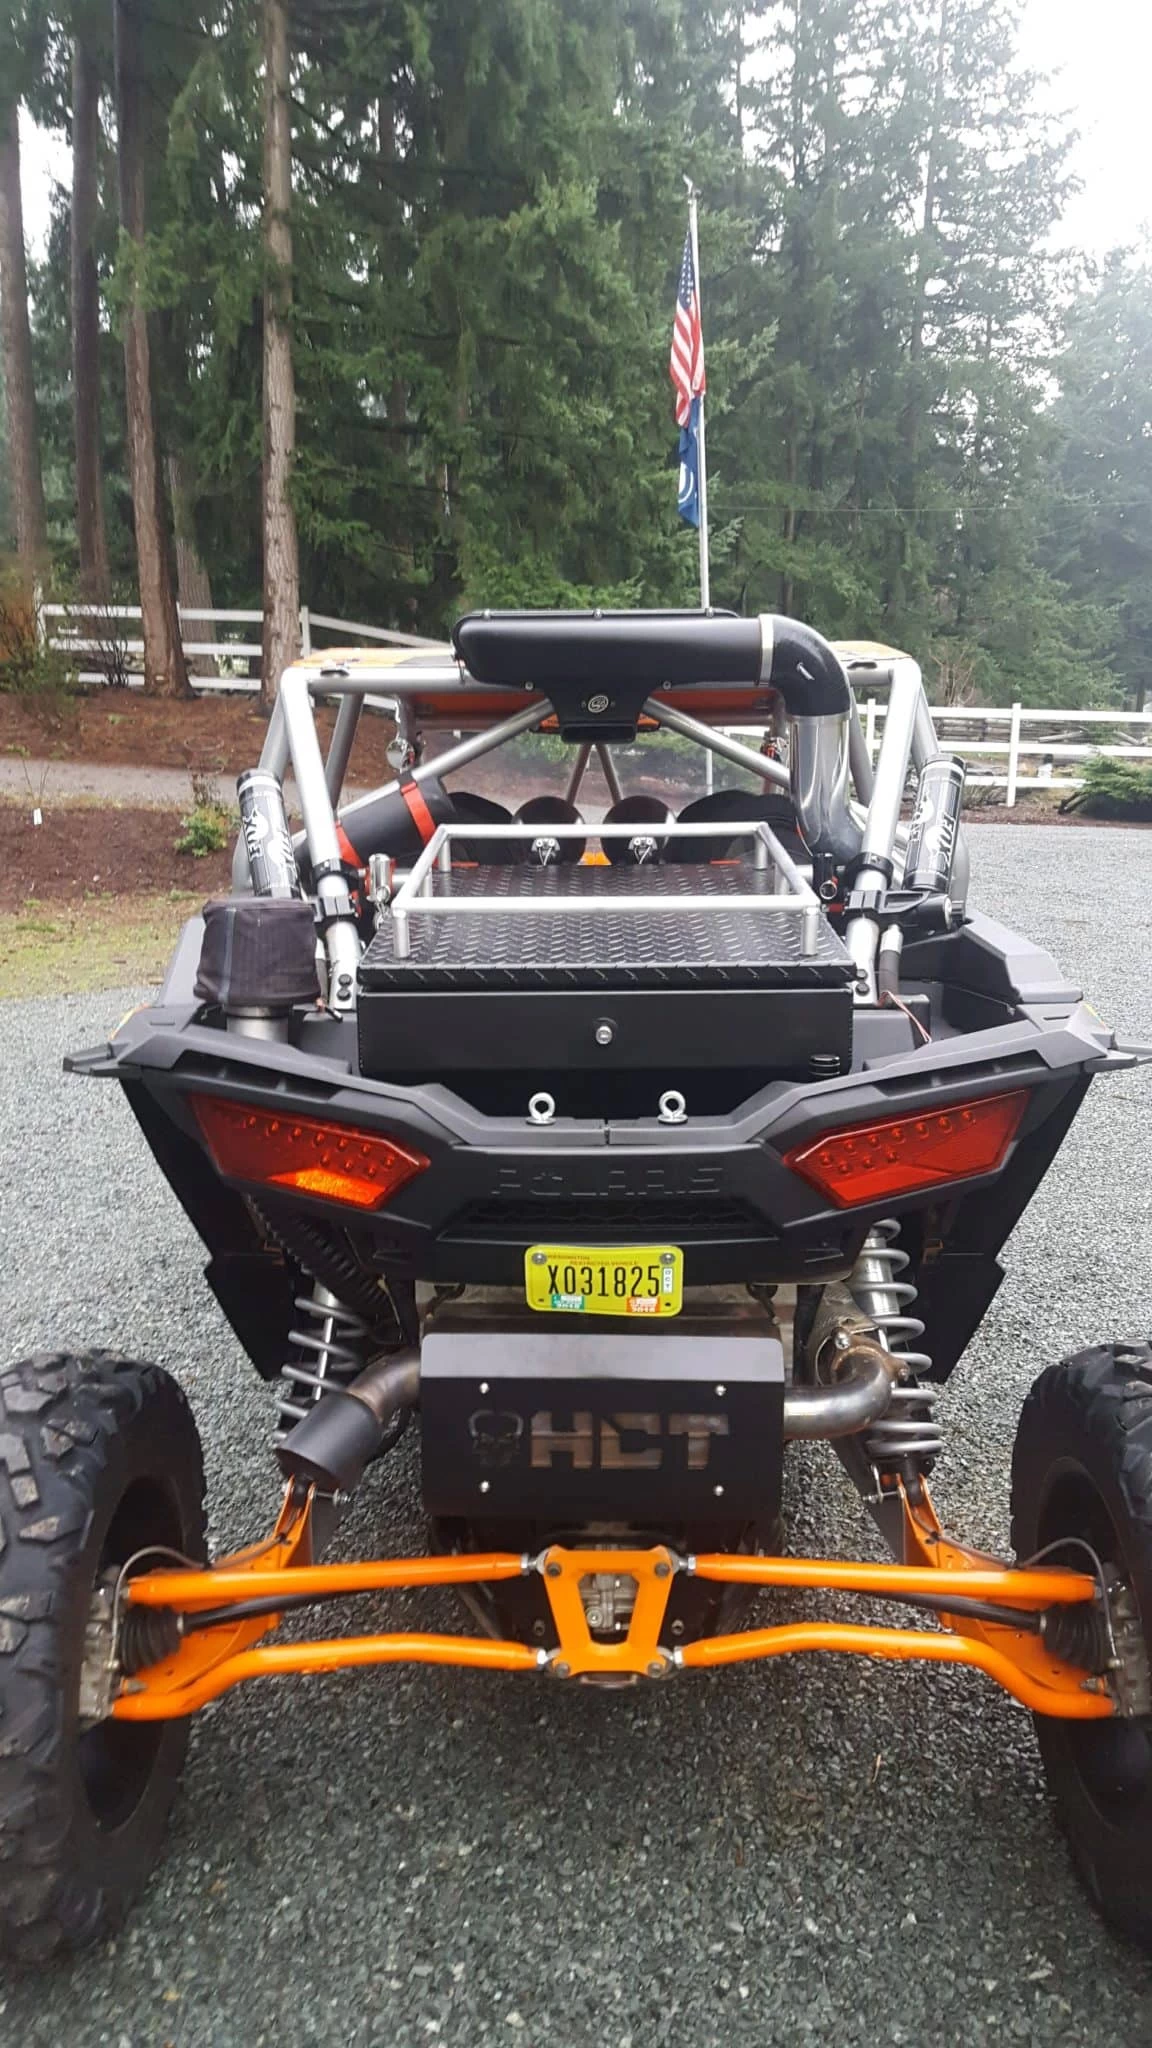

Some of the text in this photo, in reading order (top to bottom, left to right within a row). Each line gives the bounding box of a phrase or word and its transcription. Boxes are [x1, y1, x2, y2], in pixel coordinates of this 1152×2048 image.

[938, 814, 956, 868] FOX
[547, 1265, 660, 1298] X031825
[530, 1411, 729, 1470] HCT
